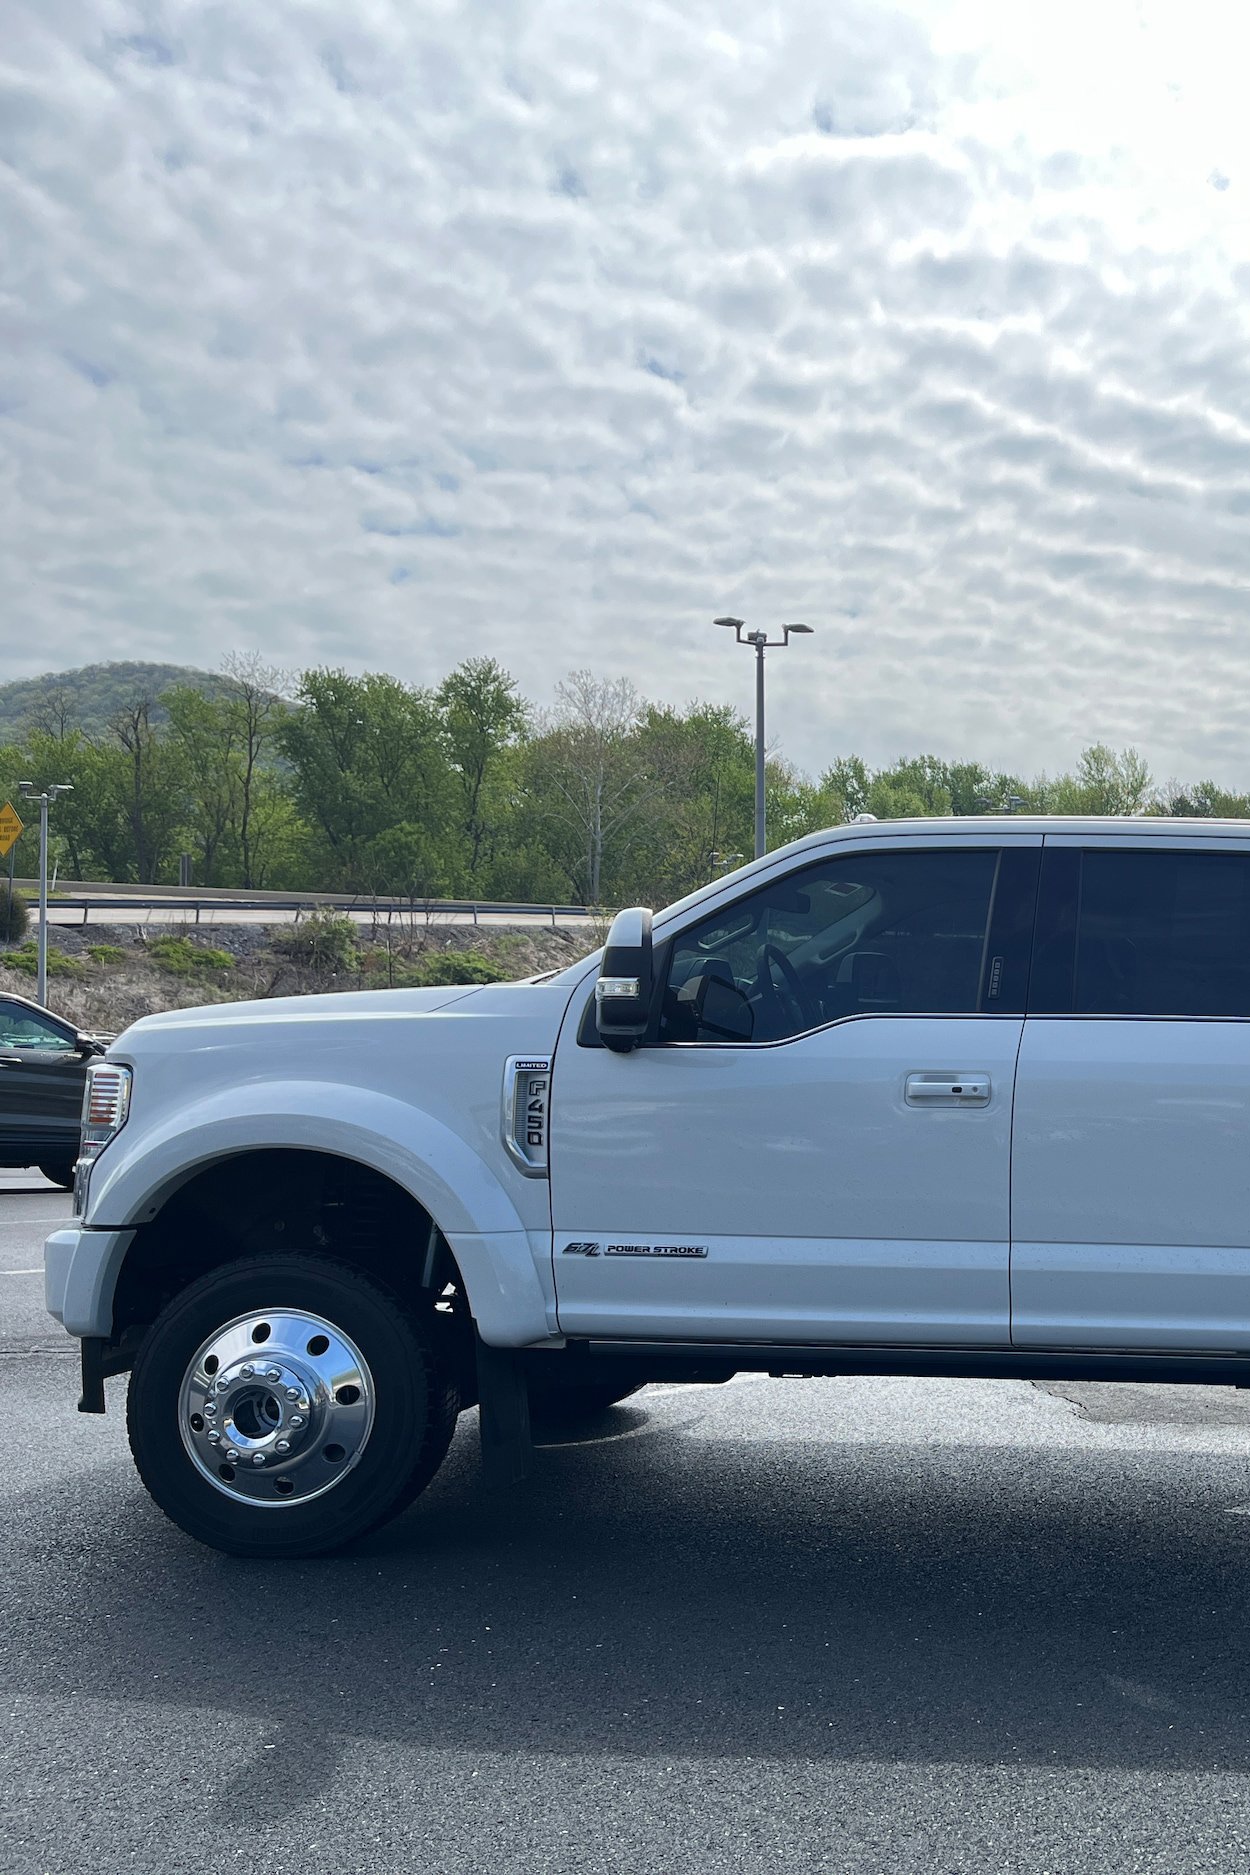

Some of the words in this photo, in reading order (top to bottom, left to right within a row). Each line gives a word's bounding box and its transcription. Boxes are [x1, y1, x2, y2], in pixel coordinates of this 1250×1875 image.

[516, 1062, 548, 1070] LIMITED
[607, 1245, 651, 1253] POWER
[653, 1246, 704, 1254] STROKE
